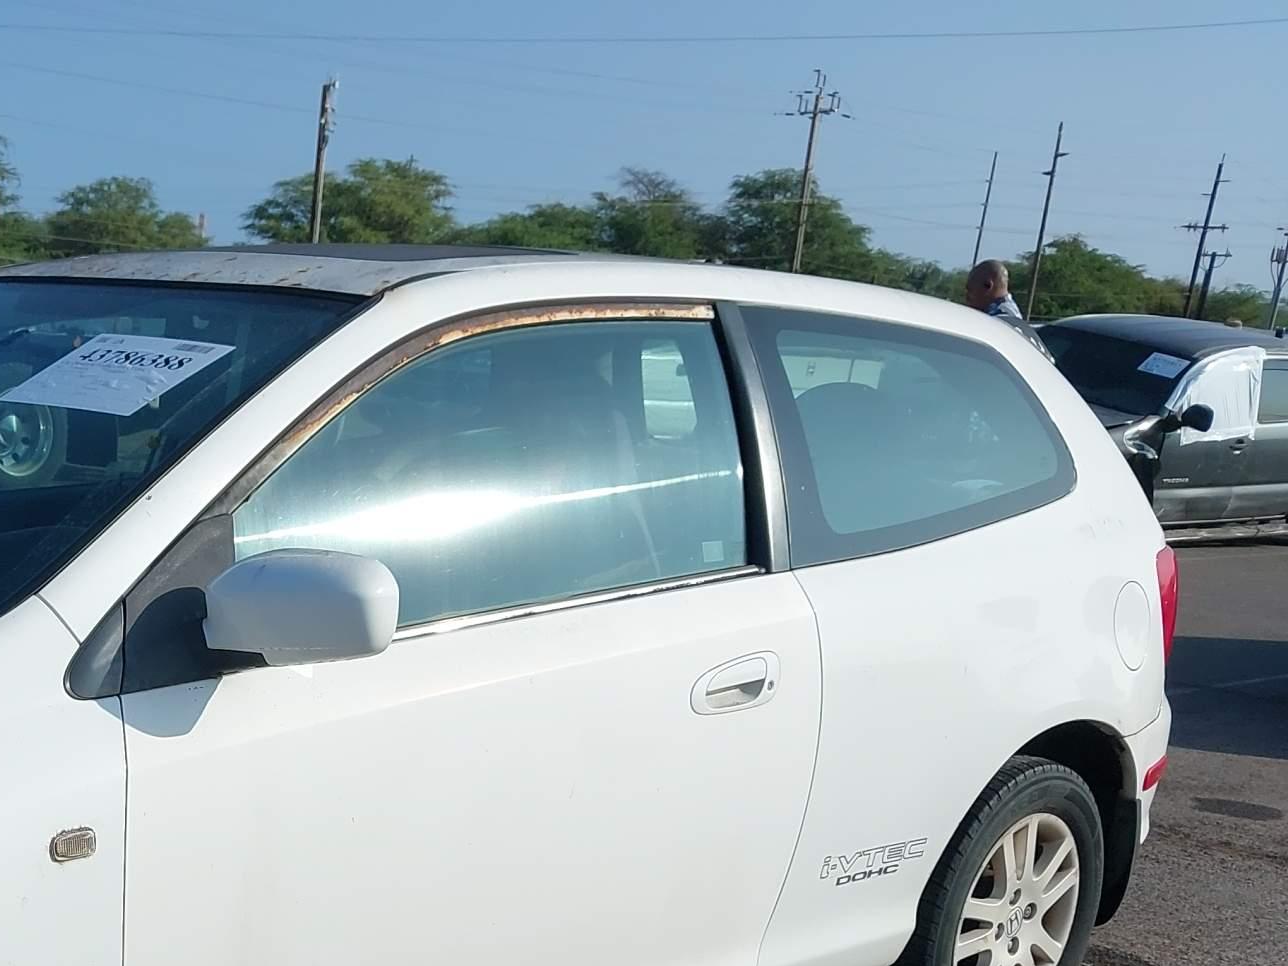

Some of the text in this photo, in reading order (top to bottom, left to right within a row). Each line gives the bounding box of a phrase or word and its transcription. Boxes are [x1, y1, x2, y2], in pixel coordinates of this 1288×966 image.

[79, 348, 193, 371] 43786388
[820, 837, 928, 879] i-VTEC
[835, 864, 900, 886] DOHC
